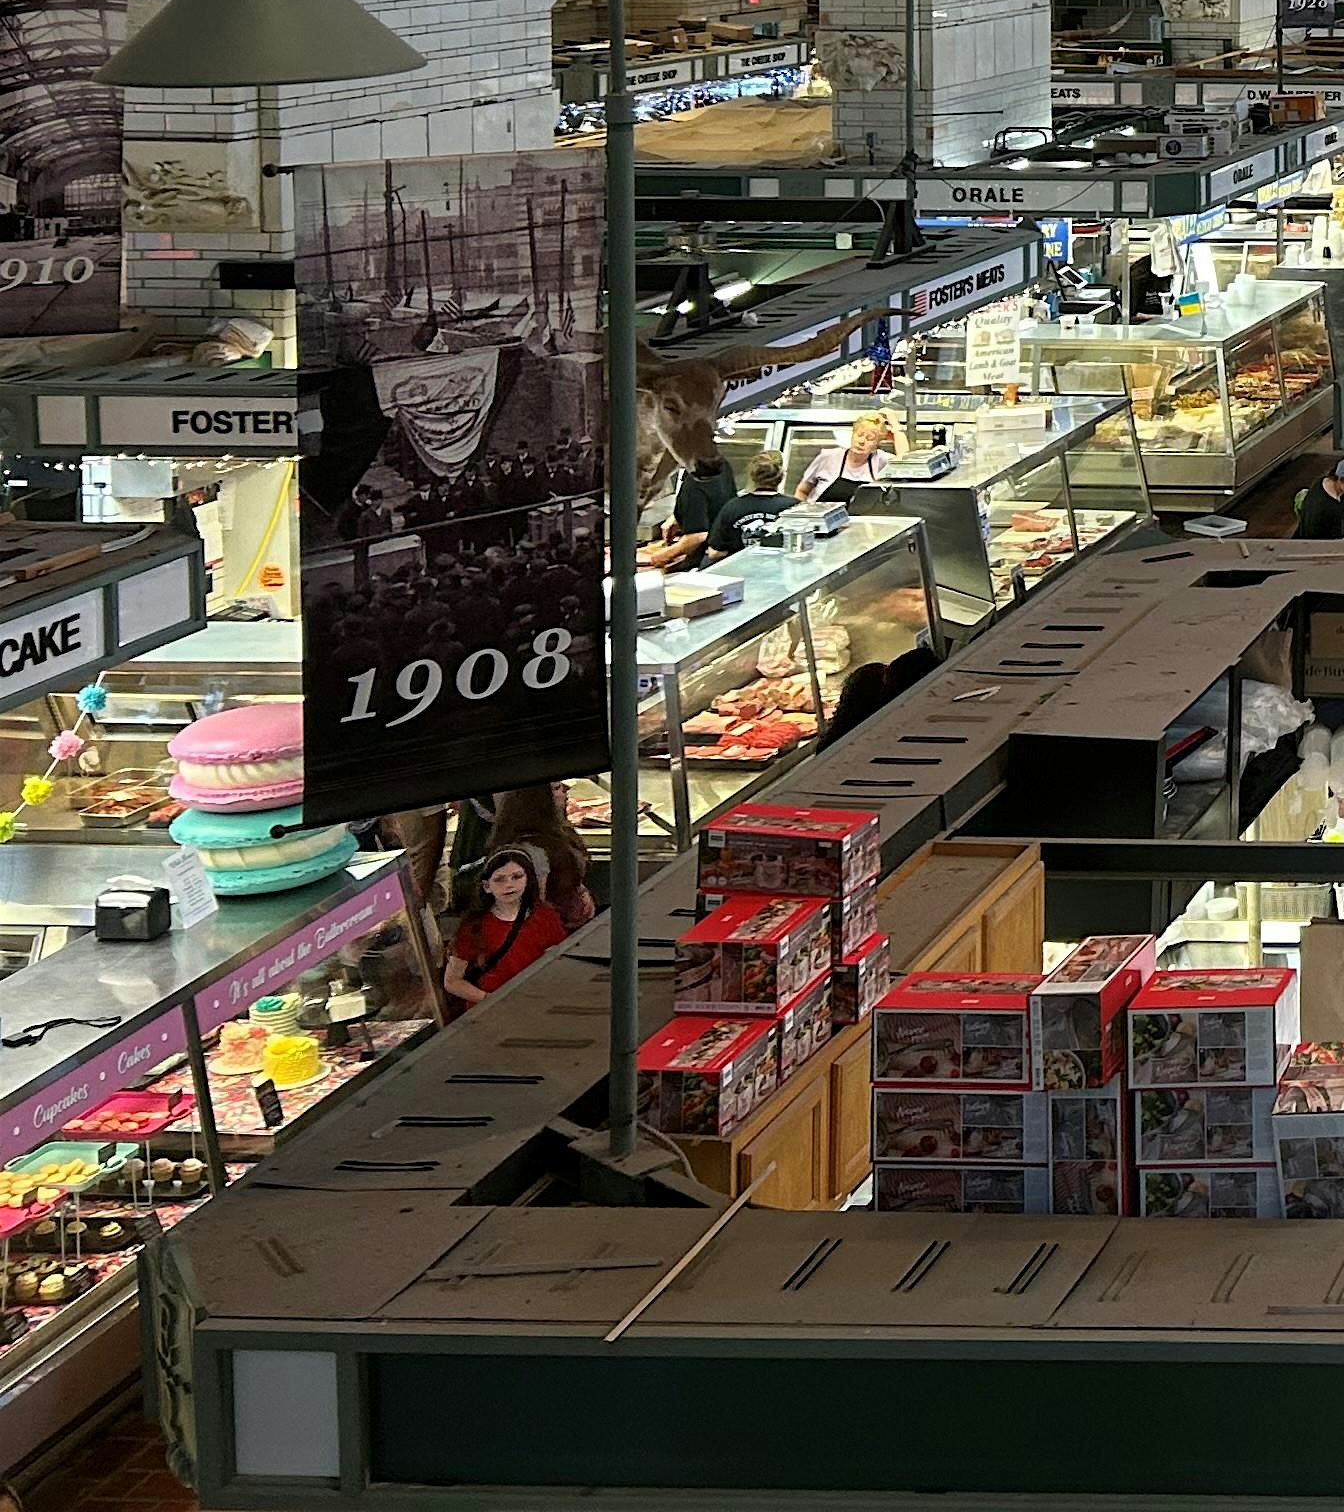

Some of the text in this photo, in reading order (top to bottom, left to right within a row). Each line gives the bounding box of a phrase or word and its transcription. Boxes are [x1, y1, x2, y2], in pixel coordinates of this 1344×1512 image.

[952, 187, 1025, 204] ORALE
[928, 275, 975, 310] FOSTER'S
[976, 263, 1006, 291] MEATS
[0, 613, 81, 678] CAKE
[339, 627, 573, 728] 1908
[268, 951, 296, 979] about
[33, 1043, 152, 1129] Cupcakes Cakes
